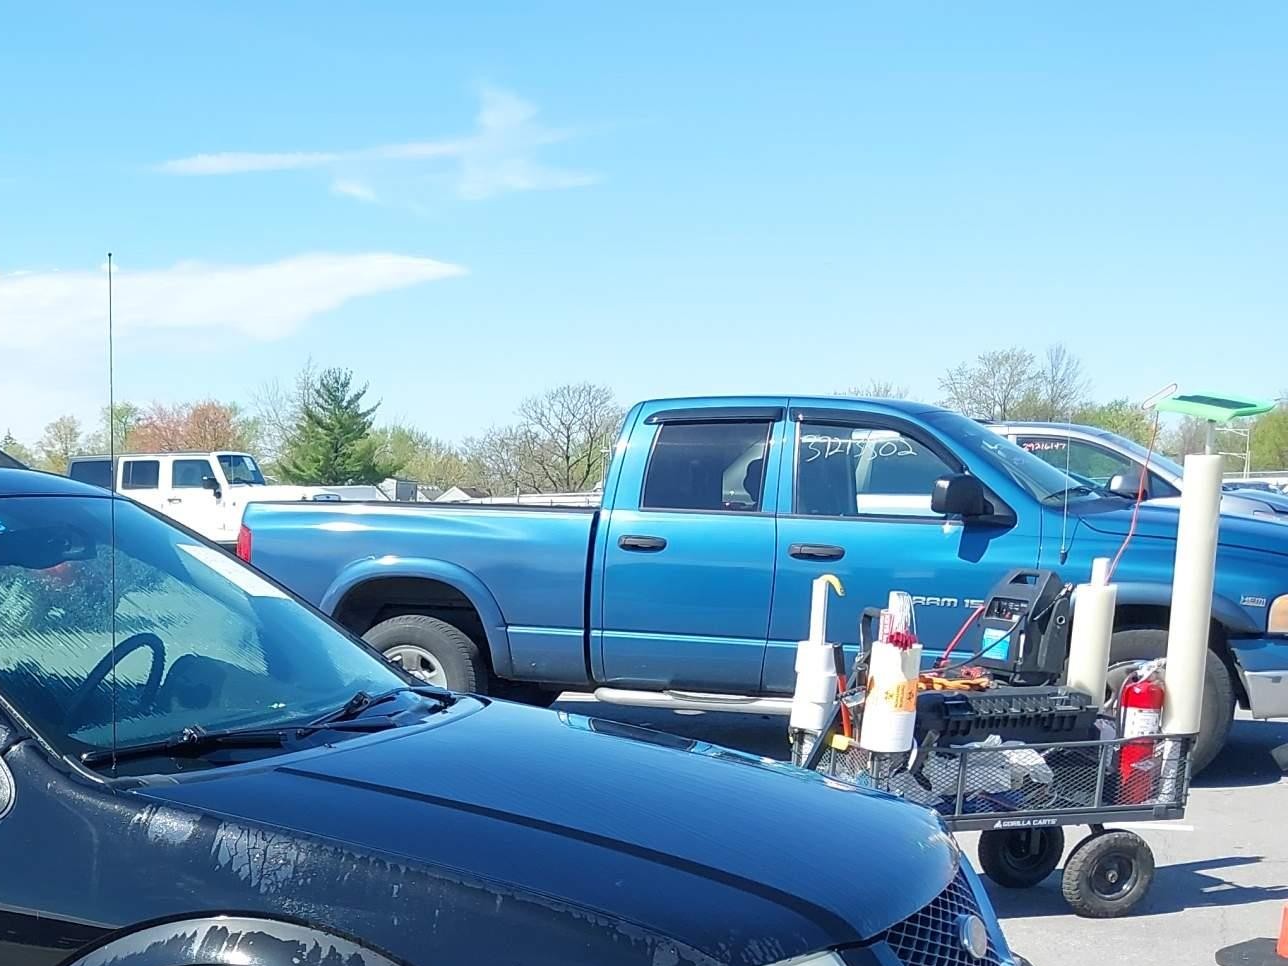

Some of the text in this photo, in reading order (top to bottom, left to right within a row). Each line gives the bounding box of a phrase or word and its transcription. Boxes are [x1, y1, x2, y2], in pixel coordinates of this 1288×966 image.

[912, 596, 985, 609] RAM 15
[1002, 820, 1032, 828] GORILLA
